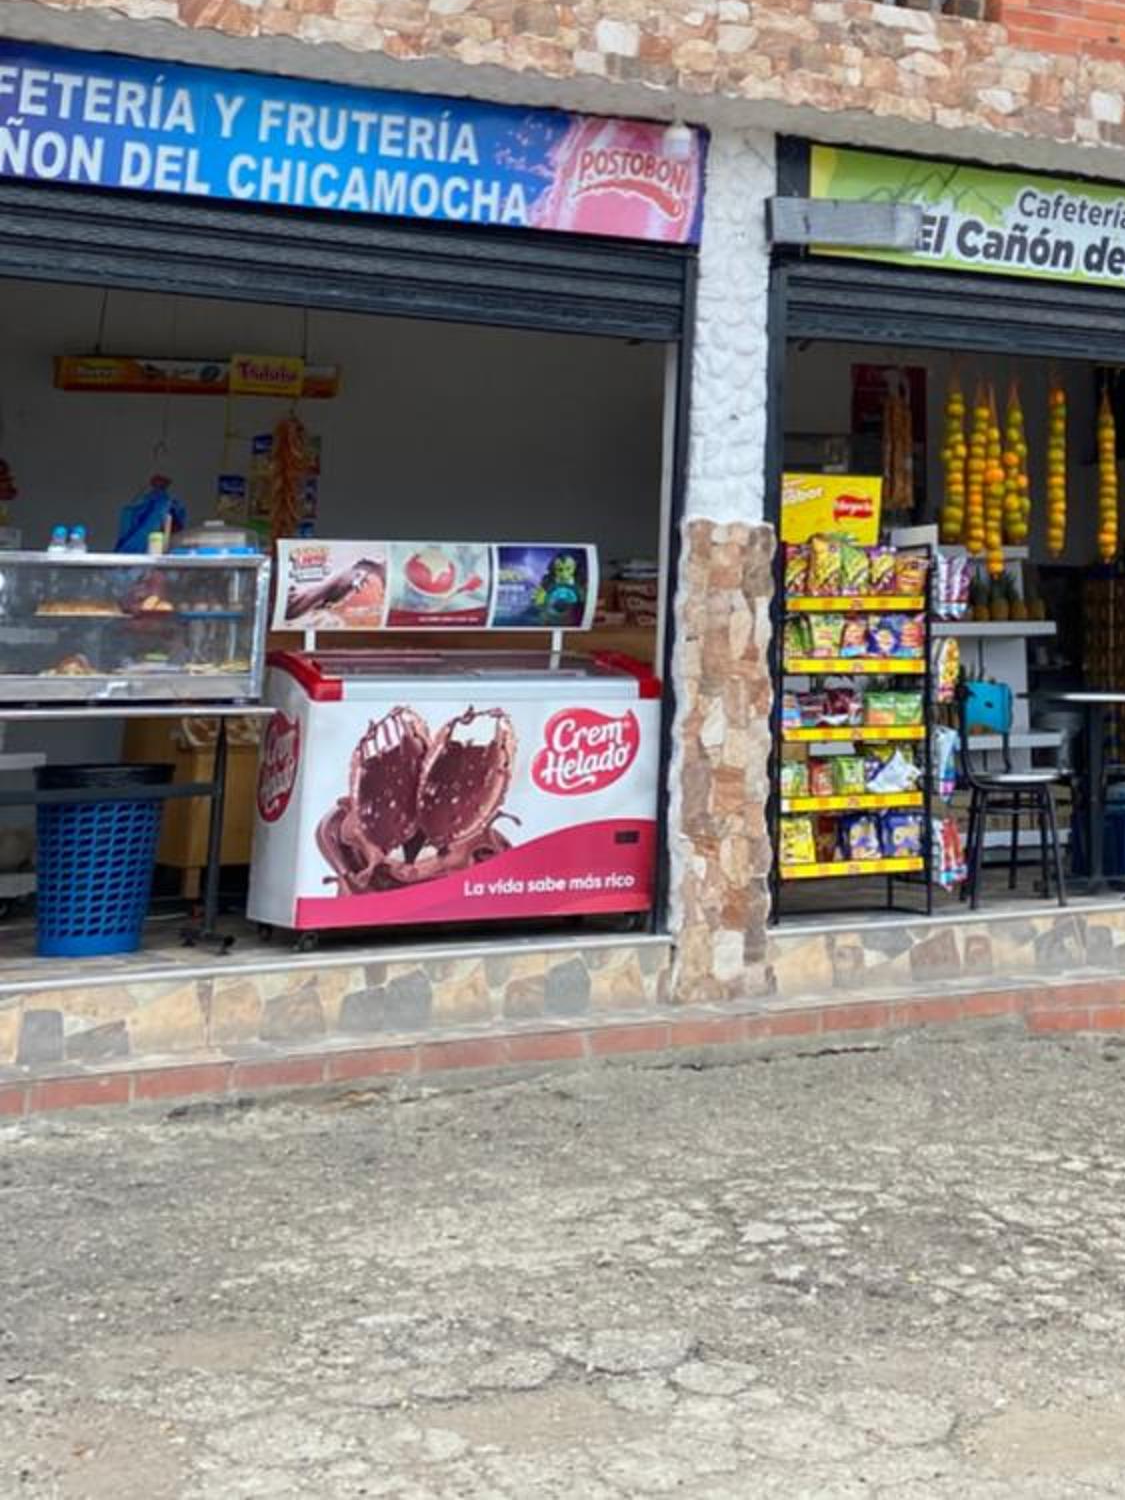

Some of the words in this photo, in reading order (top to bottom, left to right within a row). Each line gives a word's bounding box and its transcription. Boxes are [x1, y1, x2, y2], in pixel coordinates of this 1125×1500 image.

[213, 93, 245, 139] Y
[257, 99, 479, 166] FRUTERÍA
[119, 140, 210, 195] DEL
[227, 153, 528, 226] CHICAMOCHA
[916, 213, 949, 254] El
[956, 219, 1075, 269] Cañón
[552, 717, 624, 753] Crem
[540, 742, 631, 790] Helado
[463, 879, 485, 897] La
[527, 875, 567, 893] sabe
[568, 873, 602, 891] más
